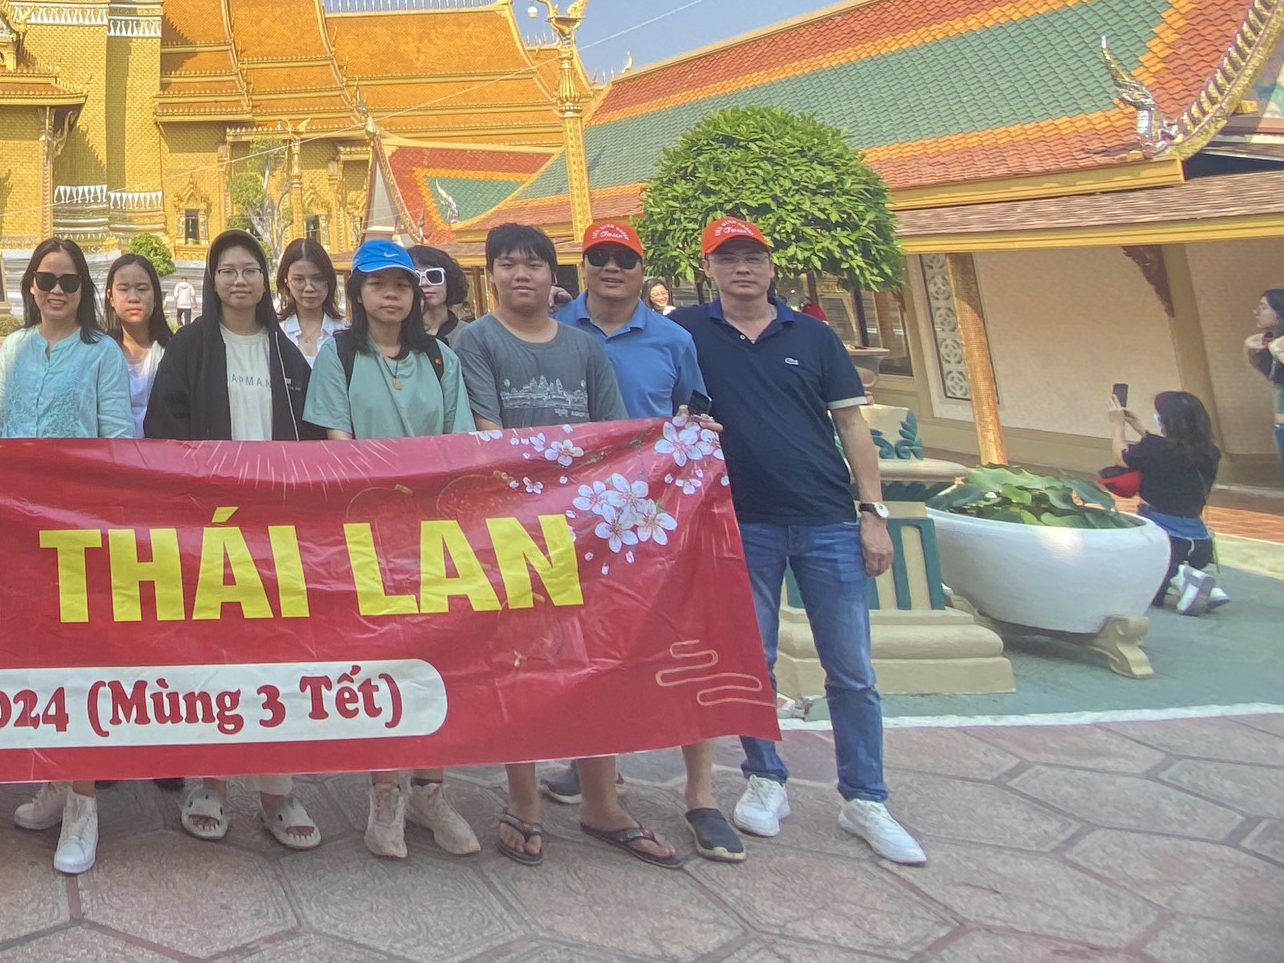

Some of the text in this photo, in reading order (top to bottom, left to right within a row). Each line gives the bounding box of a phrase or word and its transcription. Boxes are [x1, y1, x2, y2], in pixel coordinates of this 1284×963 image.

[40, 506, 310, 623] THÁI
[345, 515, 584, 615] LAN
[87, 678, 245, 736] (Mùng
[258, 685, 286, 727] 3
[300, 664, 403, 728] Tết)
